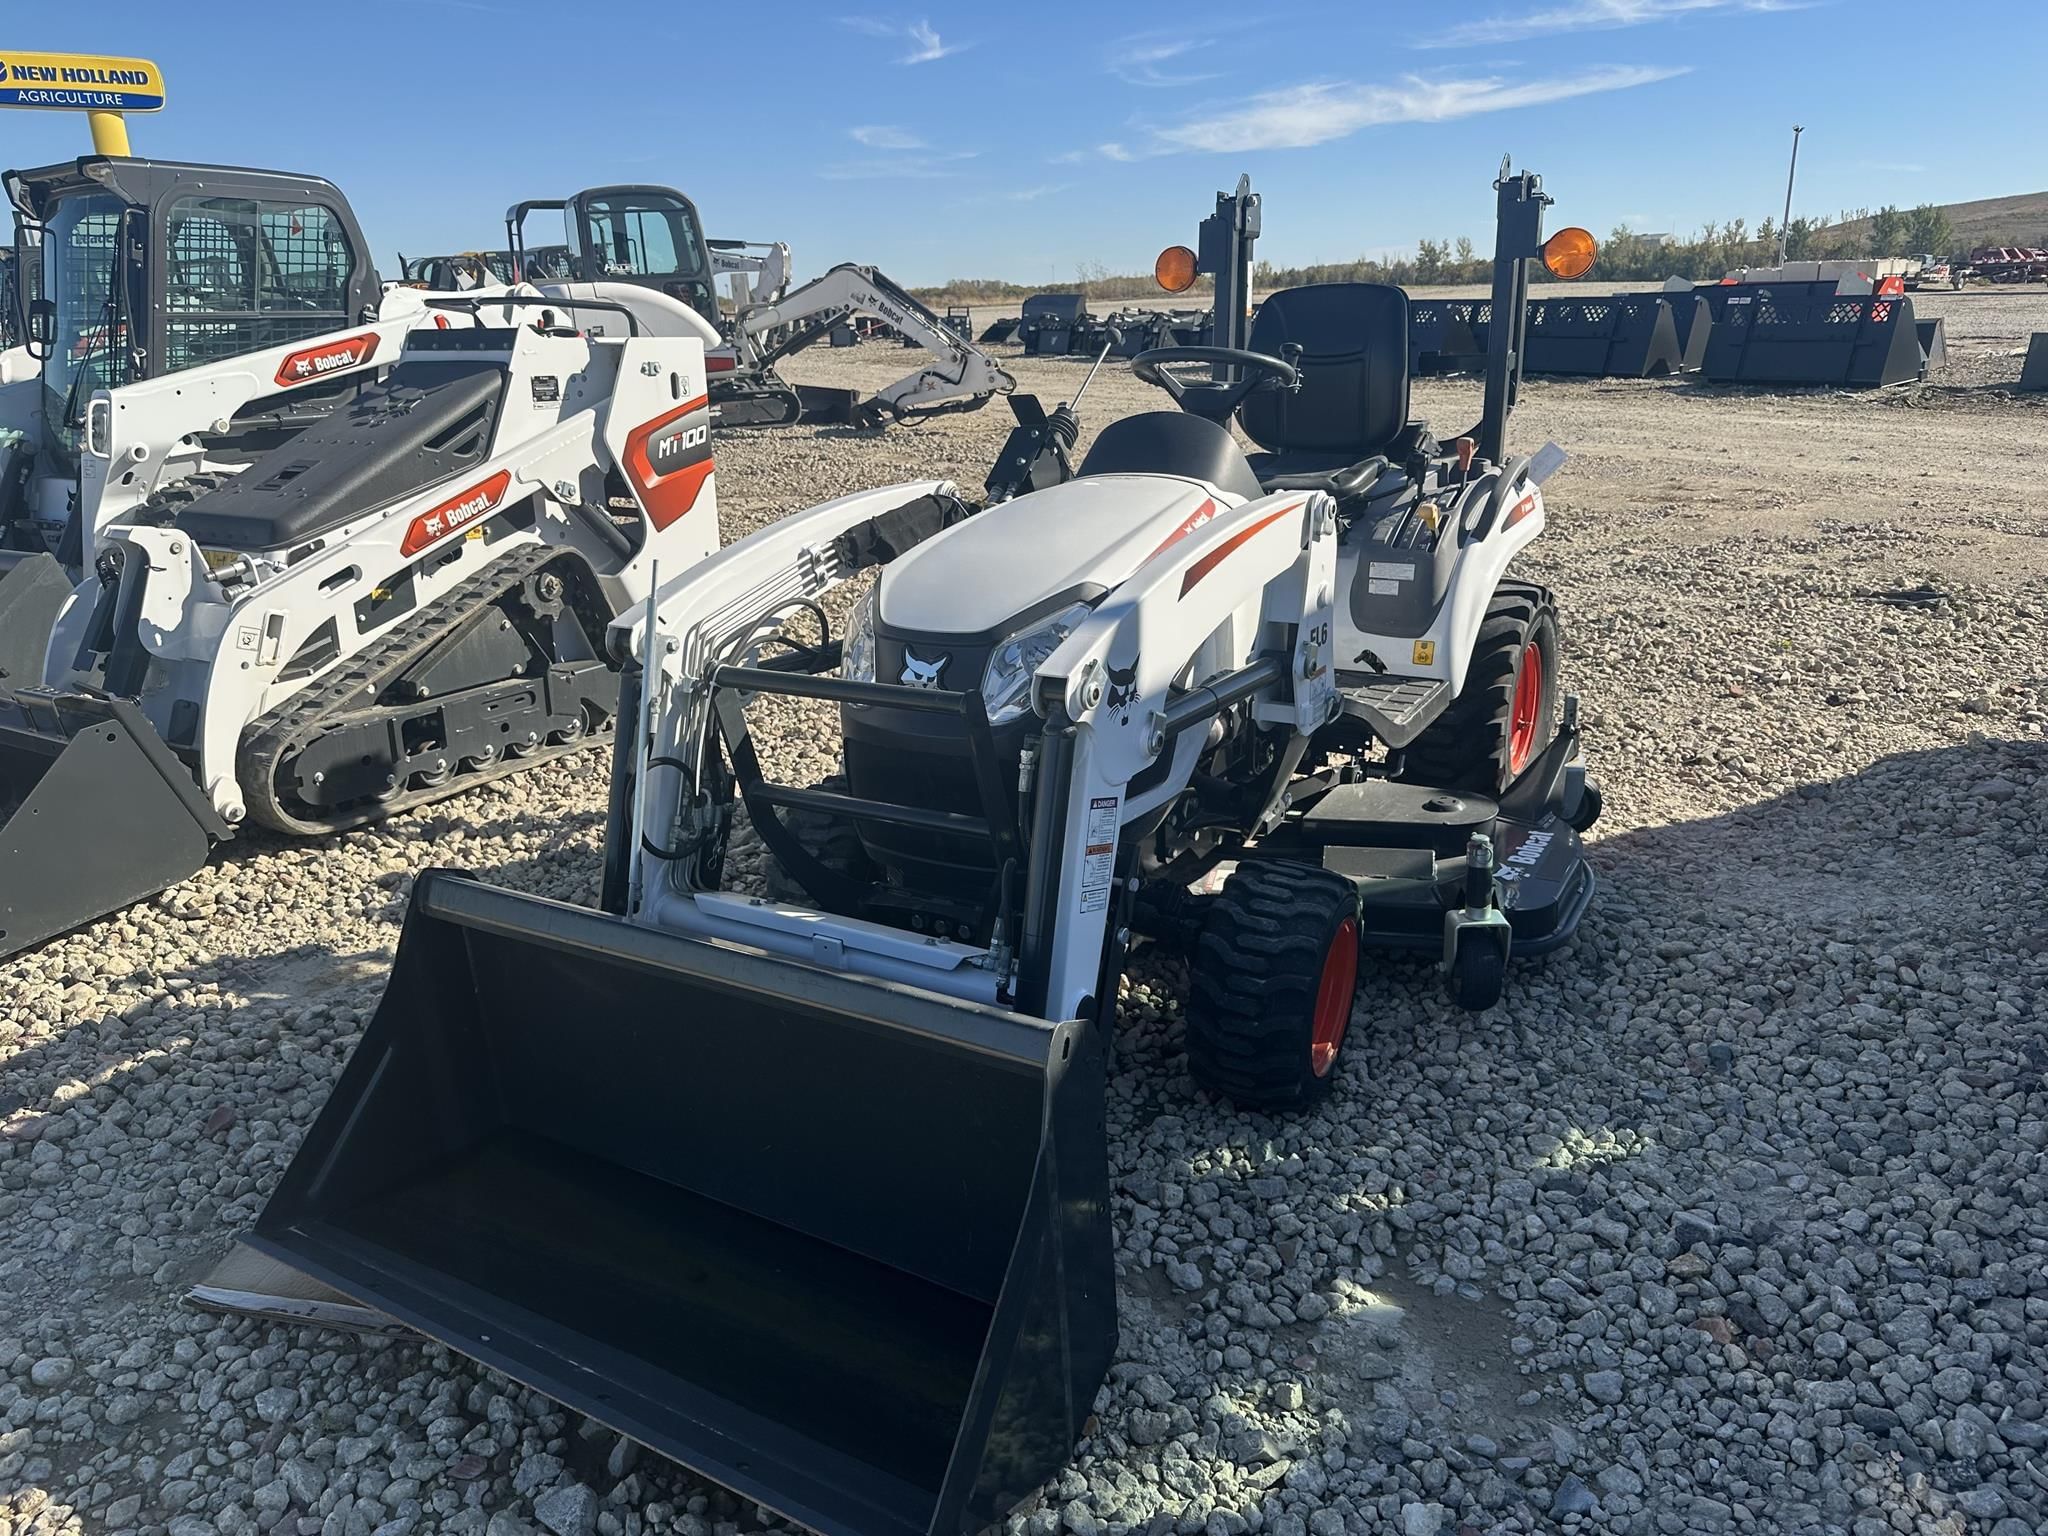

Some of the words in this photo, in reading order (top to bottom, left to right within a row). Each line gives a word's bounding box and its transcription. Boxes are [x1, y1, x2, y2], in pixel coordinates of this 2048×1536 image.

[11, 65, 57, 81] NEW
[60, 67, 149, 85] HOLLAND
[18, 90, 123, 105] AGRICULTURE
[878, 302, 904, 325] Bobcat
[314, 349, 354, 371] Bobcat
[659, 425, 707, 459] MT100
[445, 491, 491, 527] Bobcat
[1310, 622, 1328, 647] FL6
[1507, 830, 1554, 865] Bobcat
